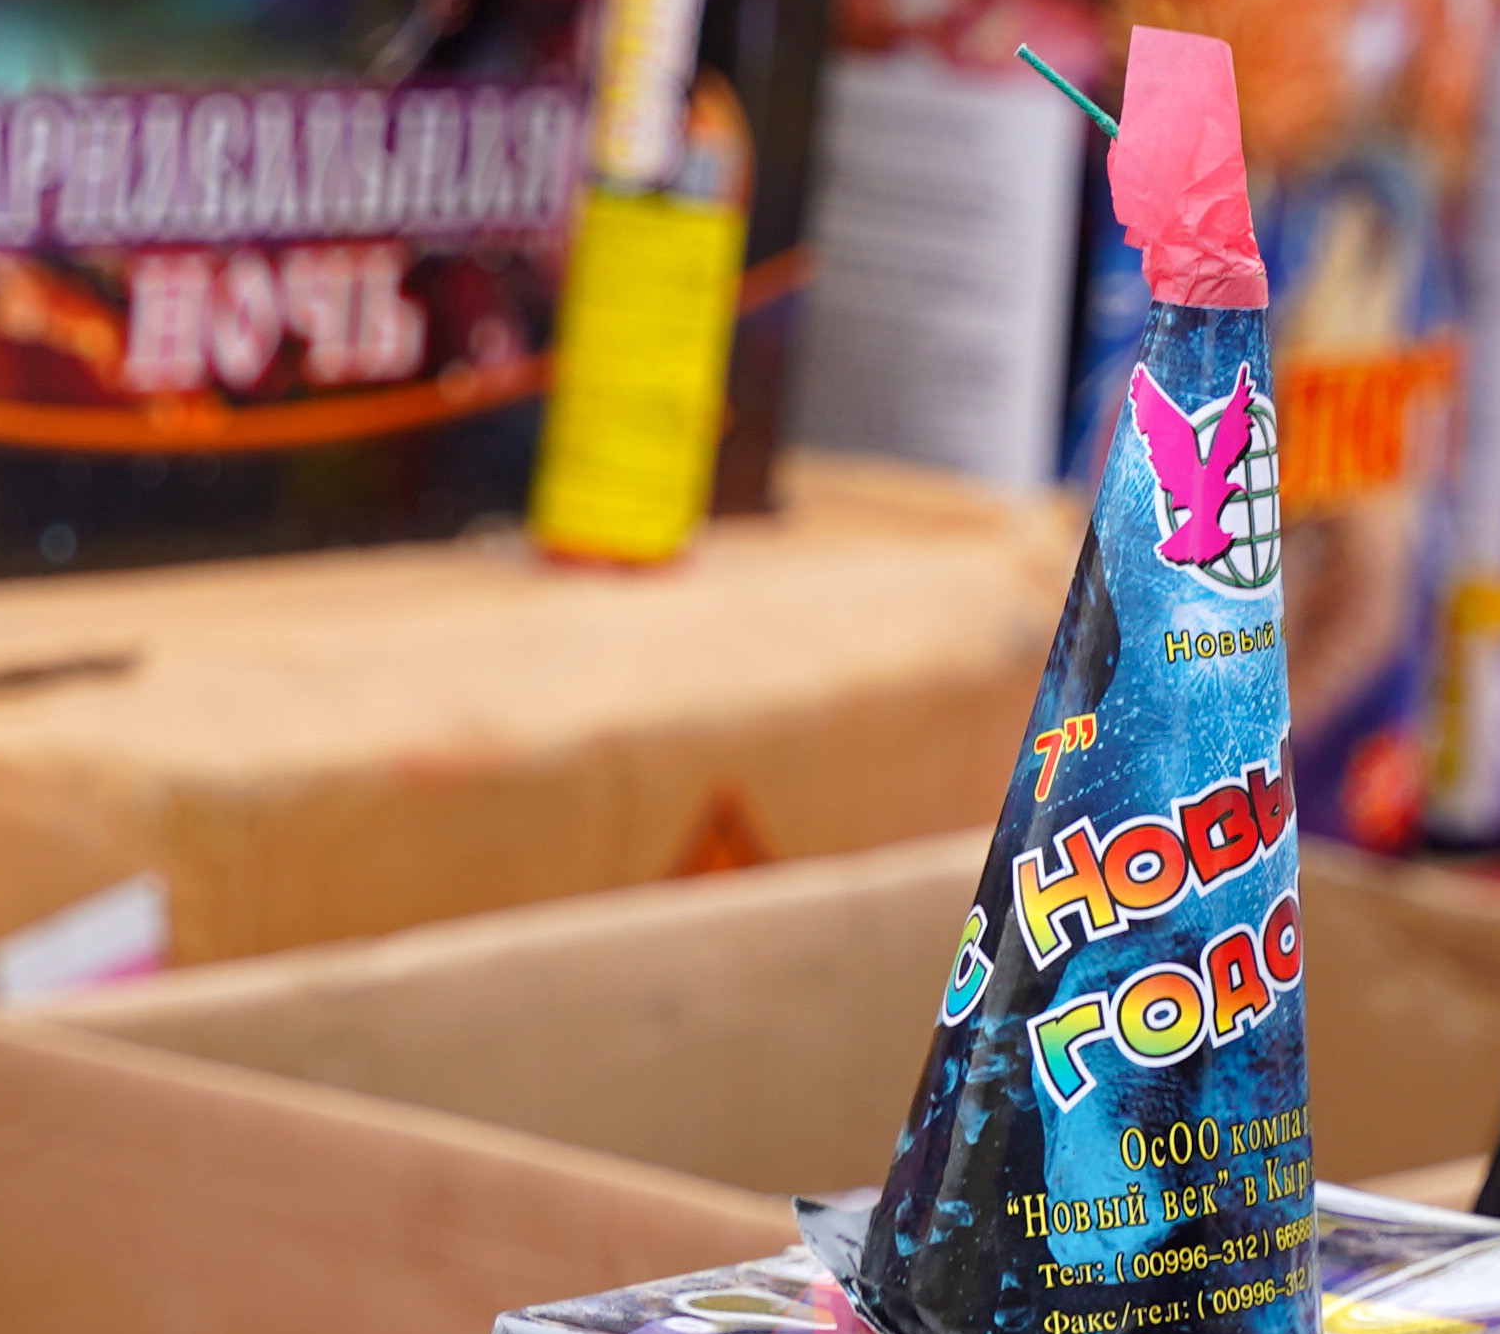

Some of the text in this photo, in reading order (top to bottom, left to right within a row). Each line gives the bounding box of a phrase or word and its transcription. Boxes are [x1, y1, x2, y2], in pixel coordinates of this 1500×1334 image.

[1165, 621, 1275, 663] Новый
[944, 731, 1297, 1027] С НОВЫ
[1027, 882, 1304, 1113] ГОДО
[1120, 1116, 1220, 1171] ОсОО
[1243, 1176, 1258, 1207] в
[1037, 1260, 1105, 1289] Тел:
